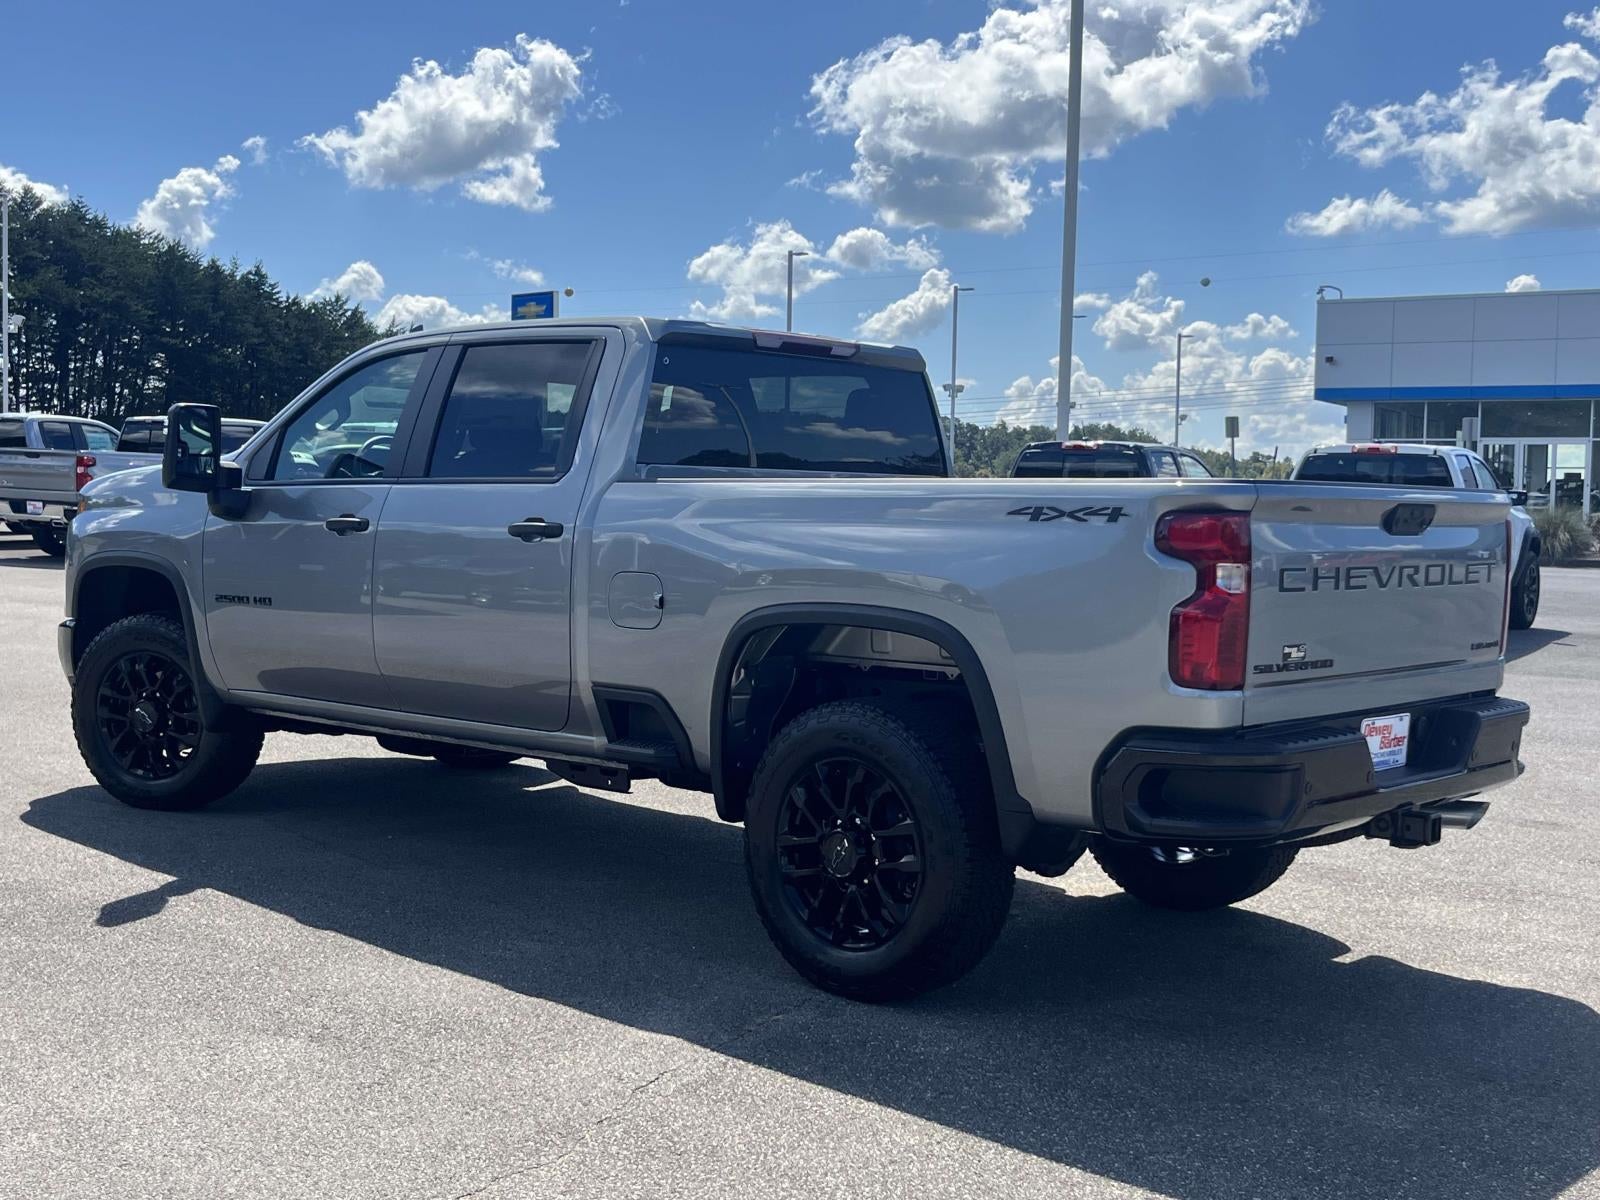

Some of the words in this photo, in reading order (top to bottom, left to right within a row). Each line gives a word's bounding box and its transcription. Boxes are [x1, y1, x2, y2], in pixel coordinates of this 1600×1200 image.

[1278, 562, 1496, 593] CHEVROLET
[215, 594, 249, 605] 2500
[253, 596, 273, 607] HD
[1253, 659, 1334, 674] SILVERADO
[1364, 724, 1392, 736] Dewey
[1380, 736, 1406, 749] Barber
